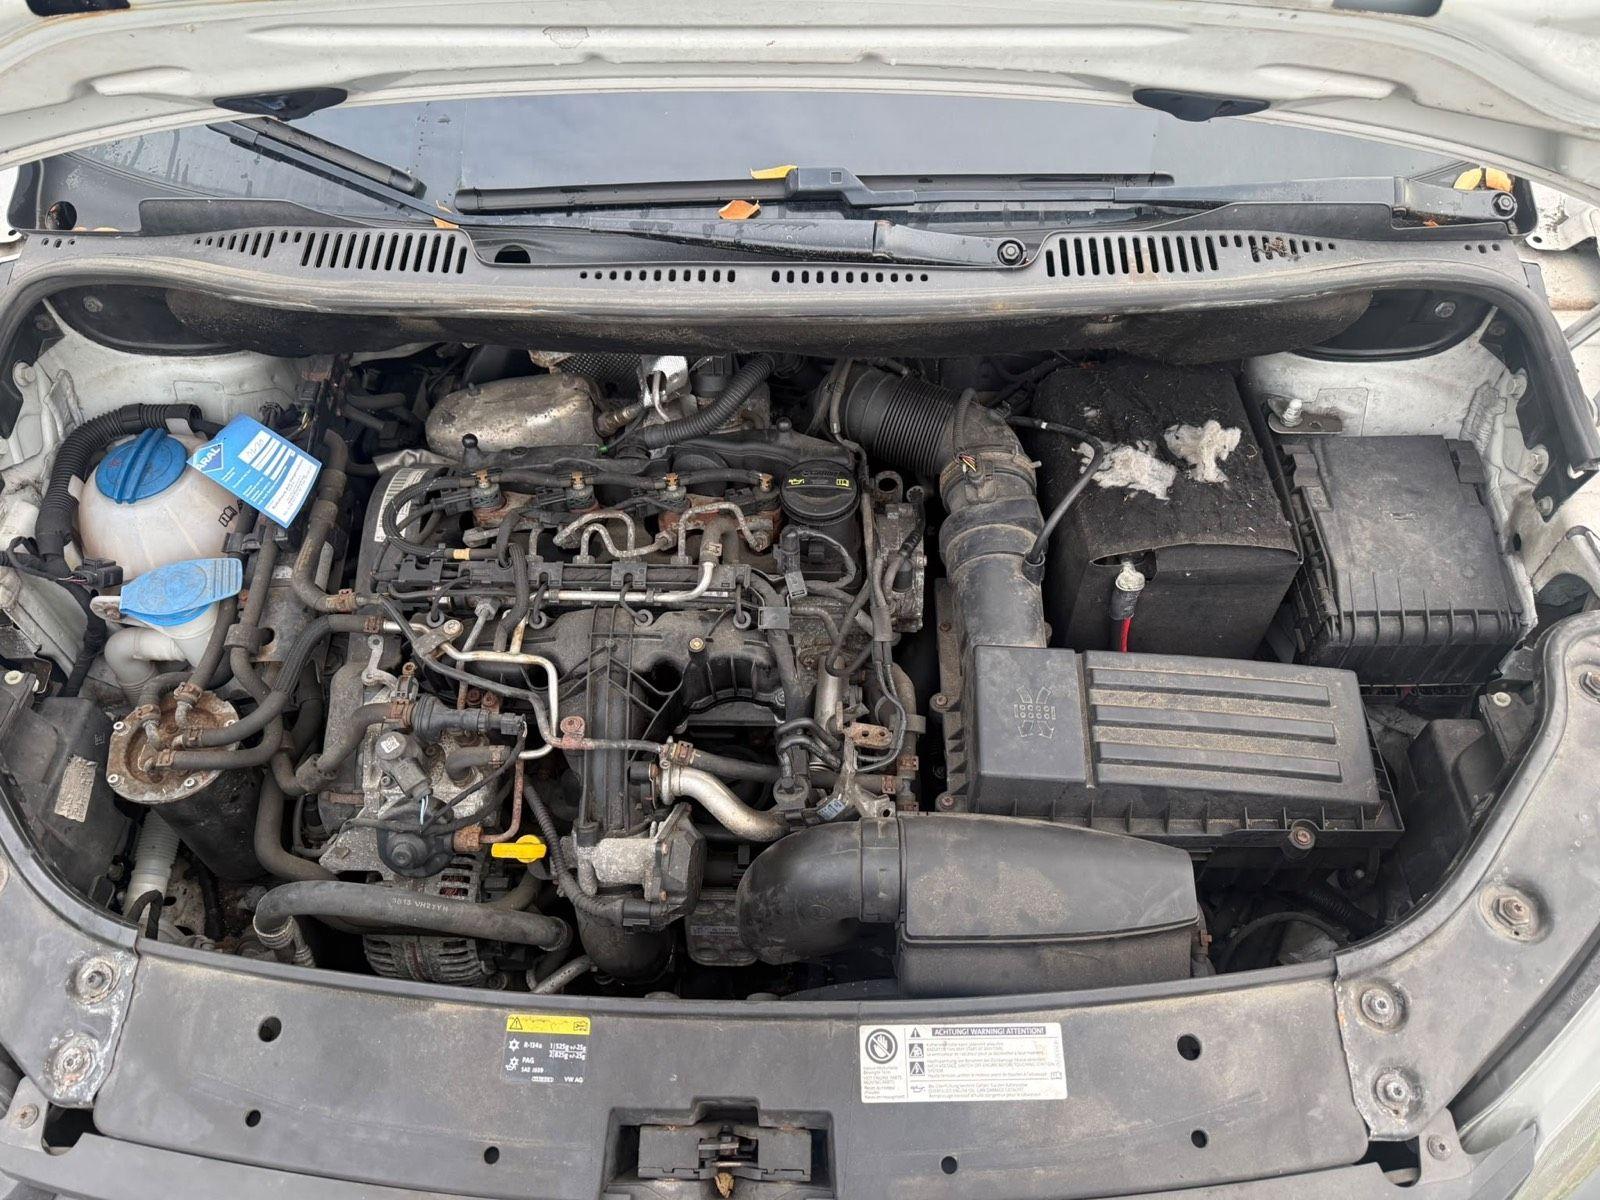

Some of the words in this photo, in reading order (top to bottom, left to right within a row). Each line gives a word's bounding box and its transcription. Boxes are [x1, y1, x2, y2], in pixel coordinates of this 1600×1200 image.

[195, 445, 221, 470] ARAL
[934, 1028, 969, 1036] ACHTUNG!
[970, 1027, 1004, 1036] WARNING!
[1006, 1026, 1045, 1035] ATTENTION!
[523, 1041, 542, 1049] R-134a
[522, 1056, 535, 1064] PAG
